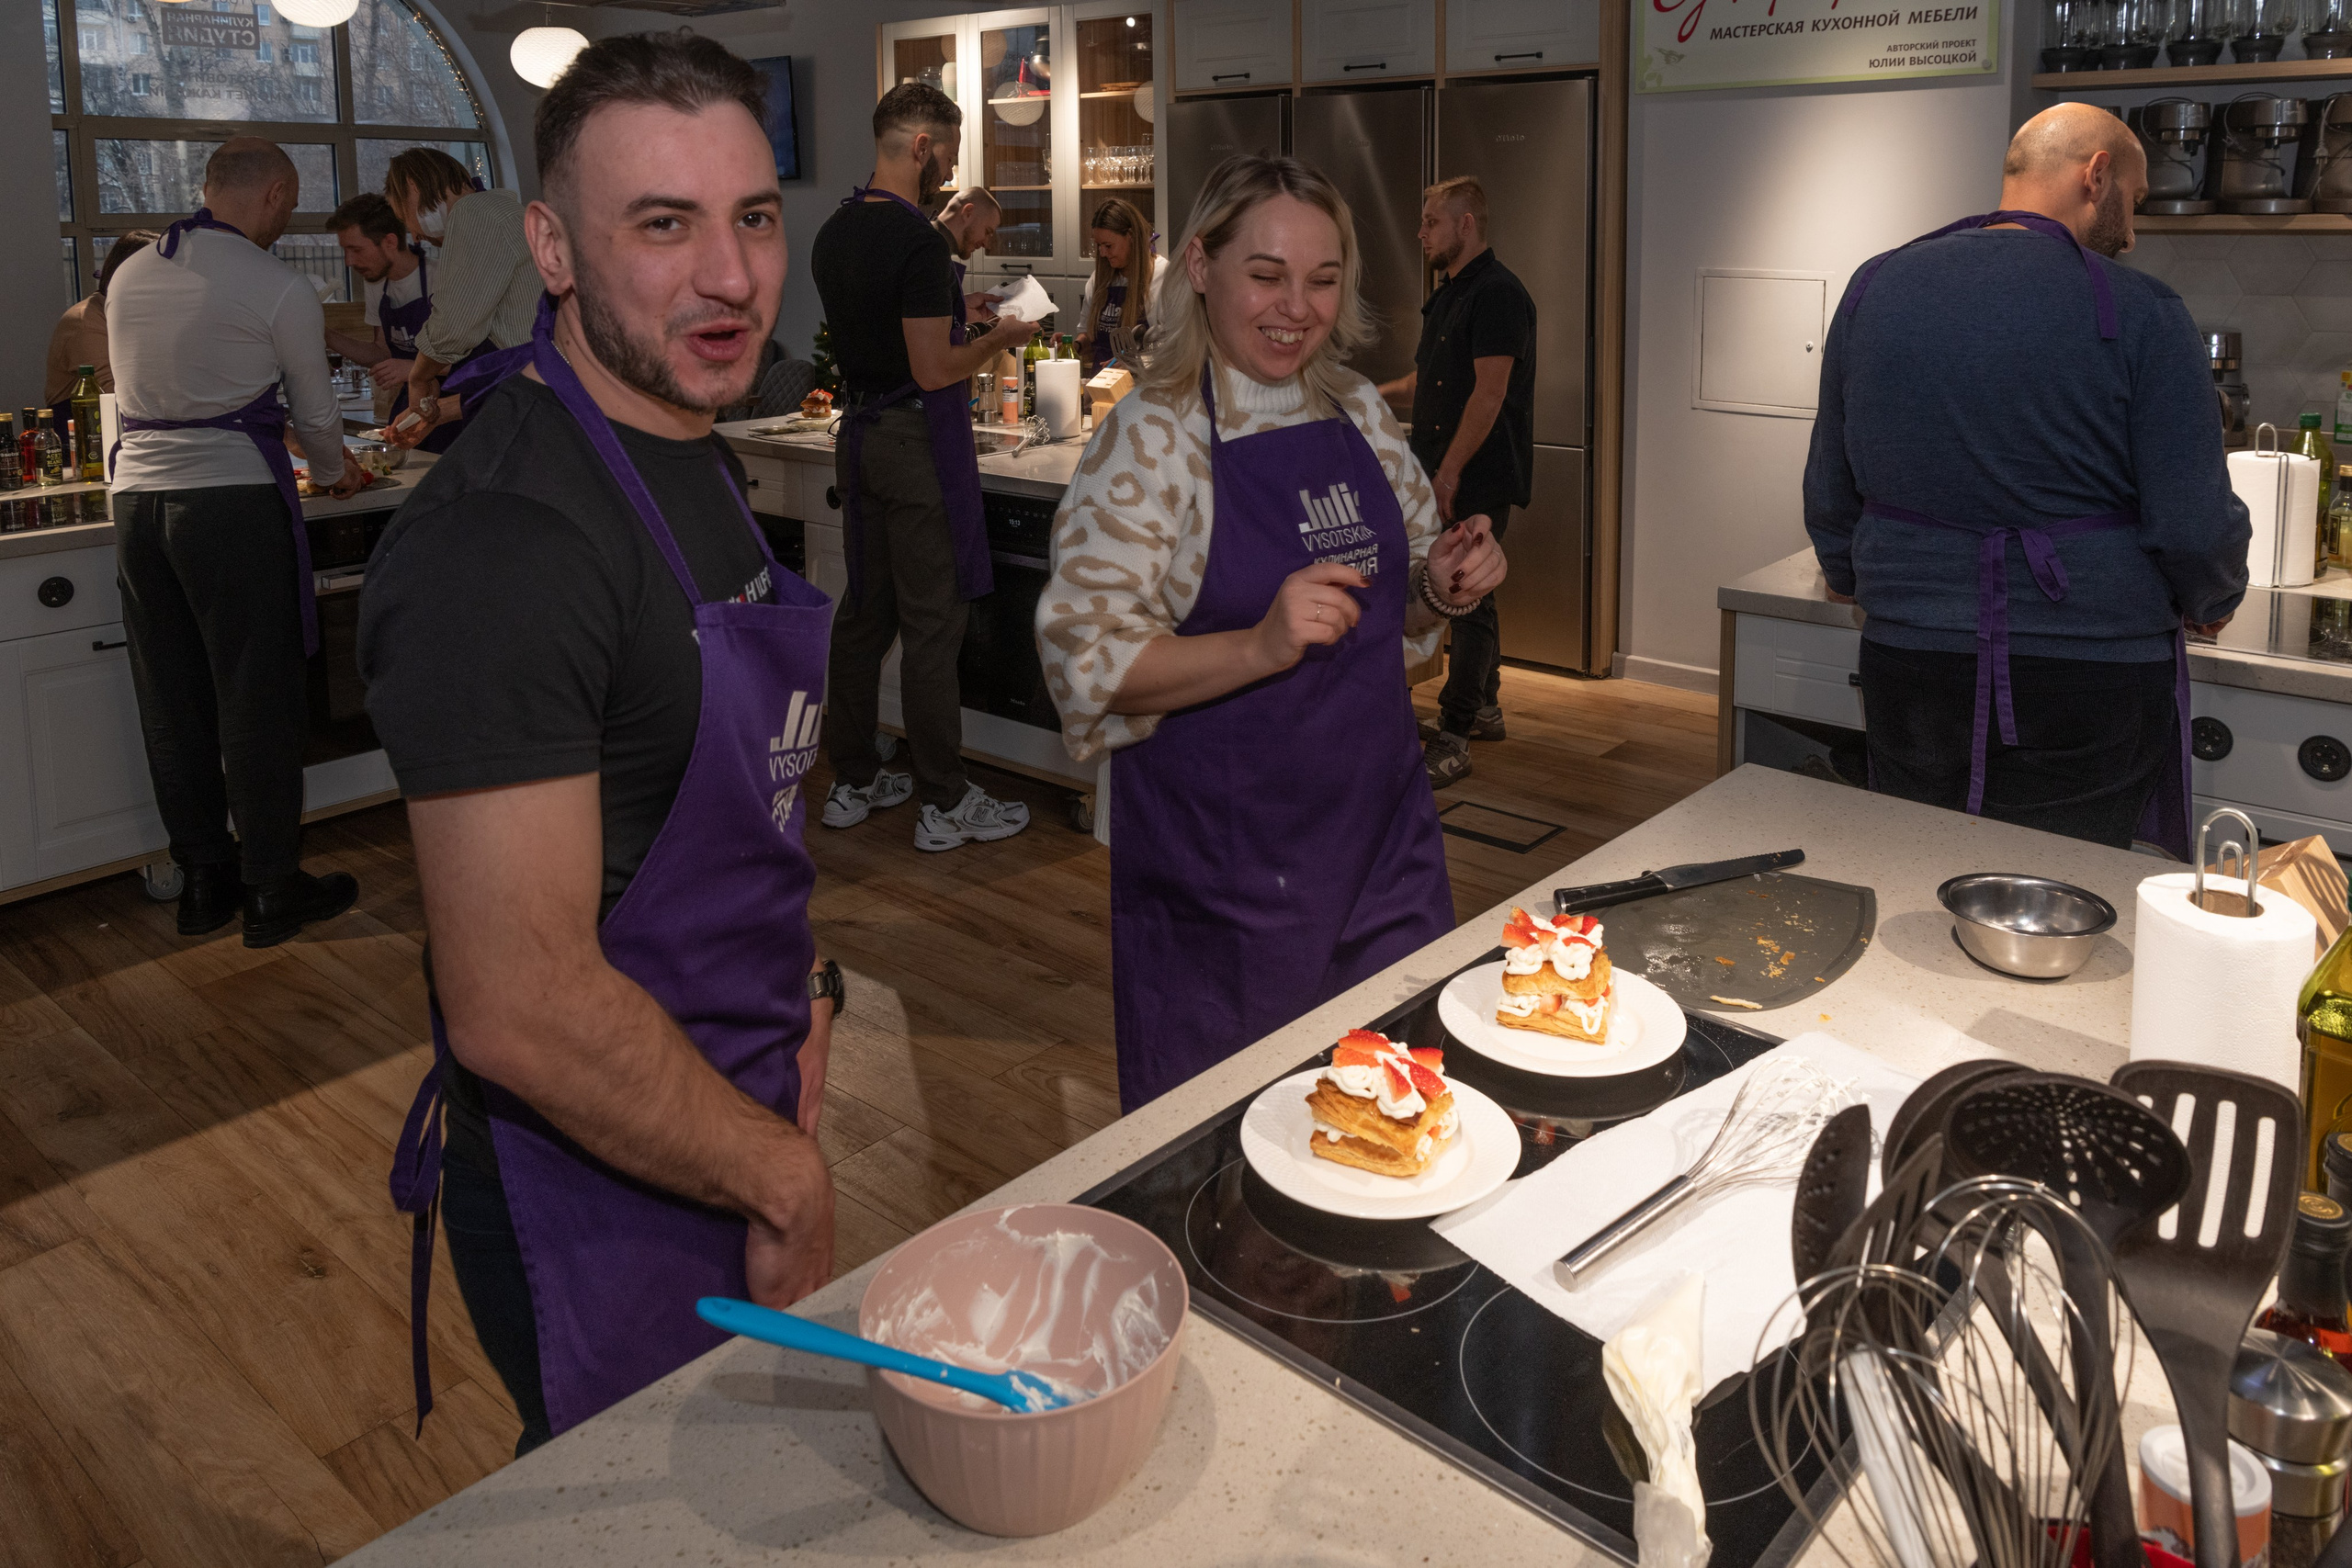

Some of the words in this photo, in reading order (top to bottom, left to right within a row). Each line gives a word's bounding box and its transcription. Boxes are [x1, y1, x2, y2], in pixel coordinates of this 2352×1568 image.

[1710, 20, 1804, 40] МАСТЕРСКАЯ
[1811, 9, 1900, 32] КУХОННОЙ
[1907, 6, 1978, 25] МЕБЕЛИ
[1886, 39, 1939, 52] АВТОРСКИЙ
[1942, 39, 1977, 49] ПРОЕКТ
[1869, 57, 1905, 69] ЮЛИИ
[1909, 51, 1977, 66] ВЫСОЦКОЙ
